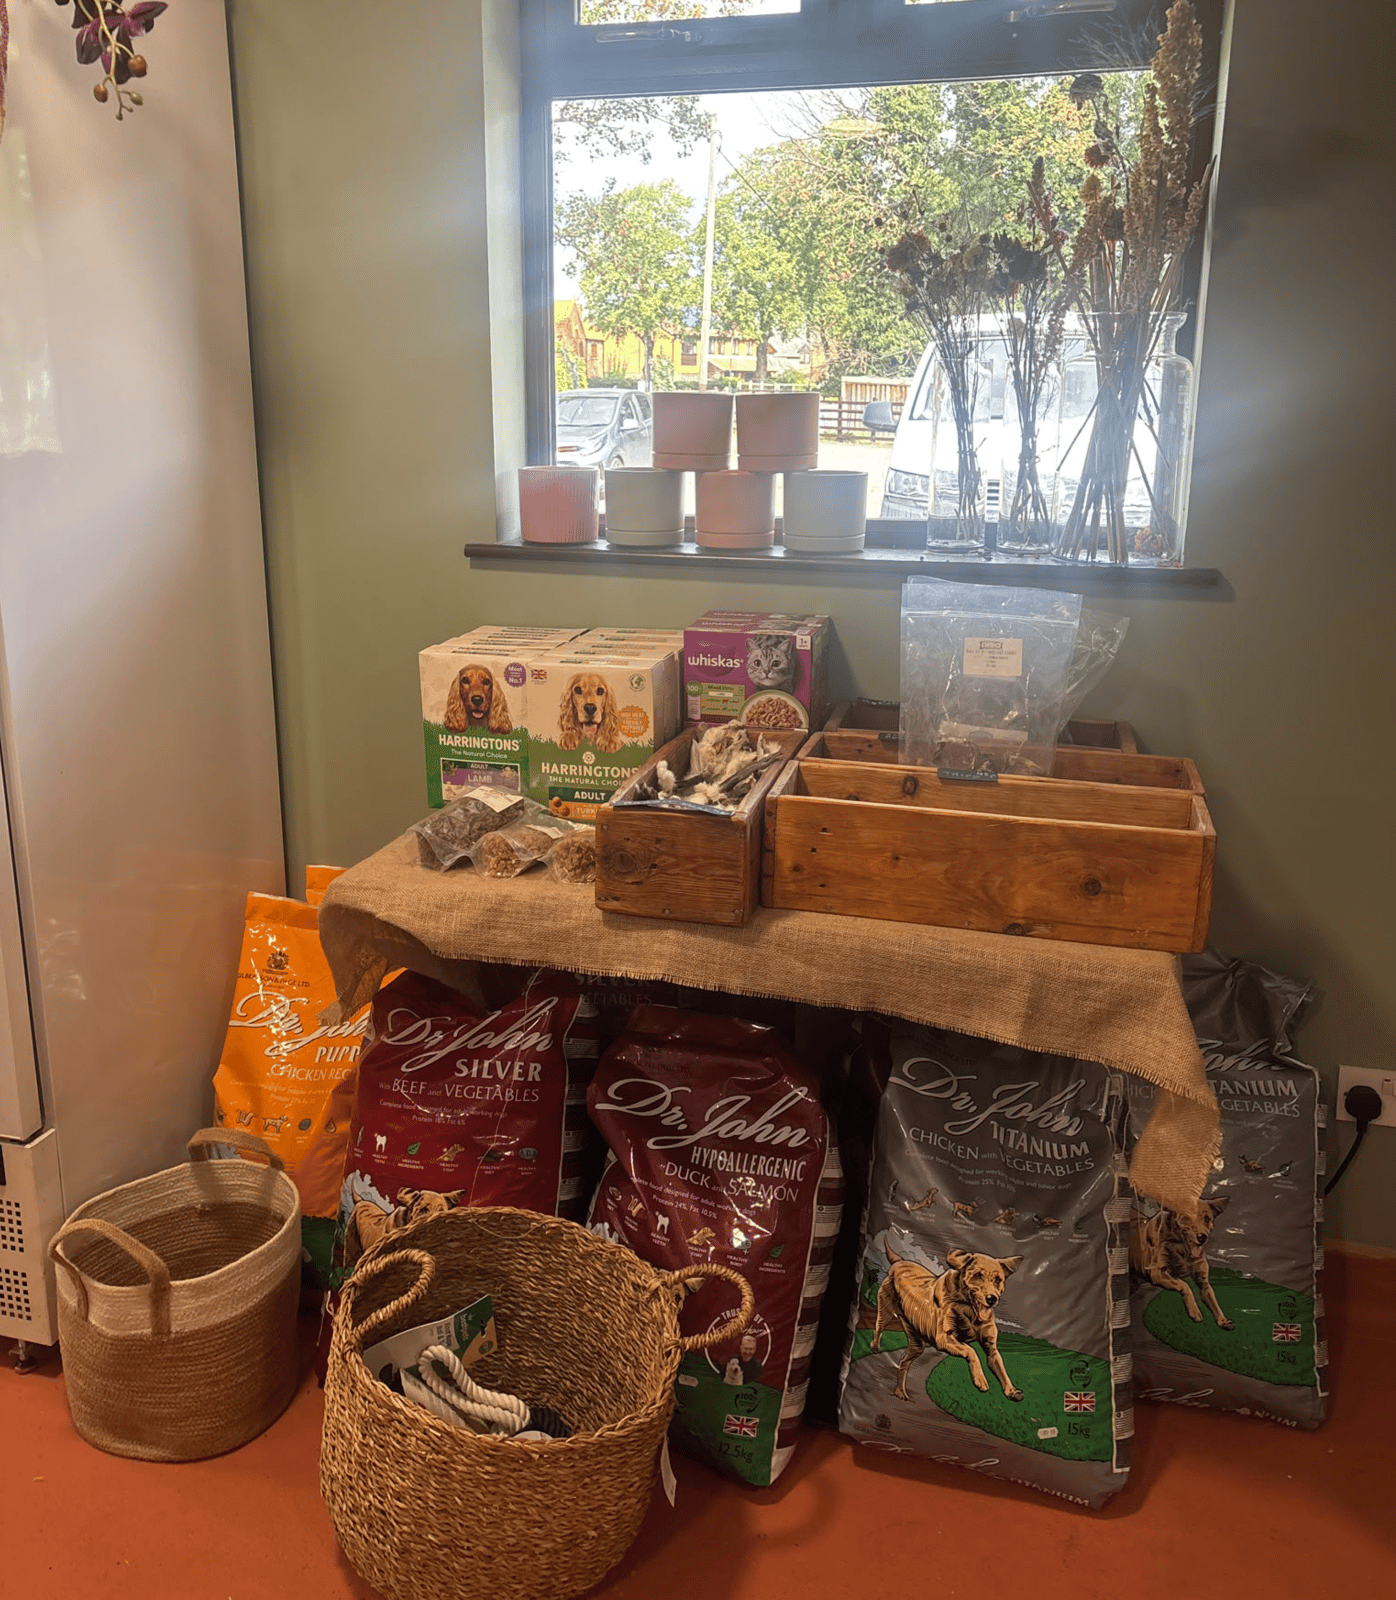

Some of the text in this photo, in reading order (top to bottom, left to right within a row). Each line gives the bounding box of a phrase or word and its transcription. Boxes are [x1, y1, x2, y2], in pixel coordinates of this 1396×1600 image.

[687, 653, 741, 668] whiskas
[438, 733, 520, 751] HARRINGTONS
[463, 750, 485, 758] Natural
[467, 774, 492, 784] LAMB
[541, 762, 639, 778] HARRINGTONS
[564, 776, 600, 786] NATURAL
[601, 779, 624, 787] CHOI
[574, 791, 606, 801] ADULT
[576, 807, 597, 815] TURK
[400, 996, 560, 1073] John
[315, 1045, 361, 1063] PUPP
[271, 1063, 353, 1081] CHICKEN REC
[454, 1058, 543, 1082] SILVER
[391, 1077, 428, 1095] BEEF
[427, 1089, 442, 1097] and
[444, 1083, 540, 1103] VEGETABLES
[889, 1057, 1087, 1137] Dr. John
[1208, 1079, 1299, 1097] TANIUM
[379, 1099, 402, 1109] Complete
[403, 1102, 416, 1110] food
[595, 1077, 810, 1150] Dr. John
[1219, 1099, 1301, 1118] GETABLES
[412, 1114, 433, 1123] Protein
[989, 1120, 1091, 1160] TITANIUM
[909, 1126, 1095, 1177] CHICKEN with VEGETABLES
[691, 1146, 807, 1182] HYPOALLERGENIC
[664, 1161, 711, 1189] DUCK
[728, 1177, 799, 1202] SALMON
[958, 1175, 981, 1186] Protein
[981, 1178, 995, 1186] 25%
[649, 1181, 663, 1192] food
[663, 1187, 690, 1198] designed
[690, 1192, 700, 1201] for
[652, 1194, 674, 1207] Protein
[689, 1204, 700, 1213] Fat
[701, 1207, 718, 1220] 10.5%
[726, 1254, 749, 1263] HEALTHY
[721, 1307, 765, 1325] TRUS BY
[1067, 1422, 1091, 1439] 15kg
[719, 1441, 754, 1464] 12.5kg
